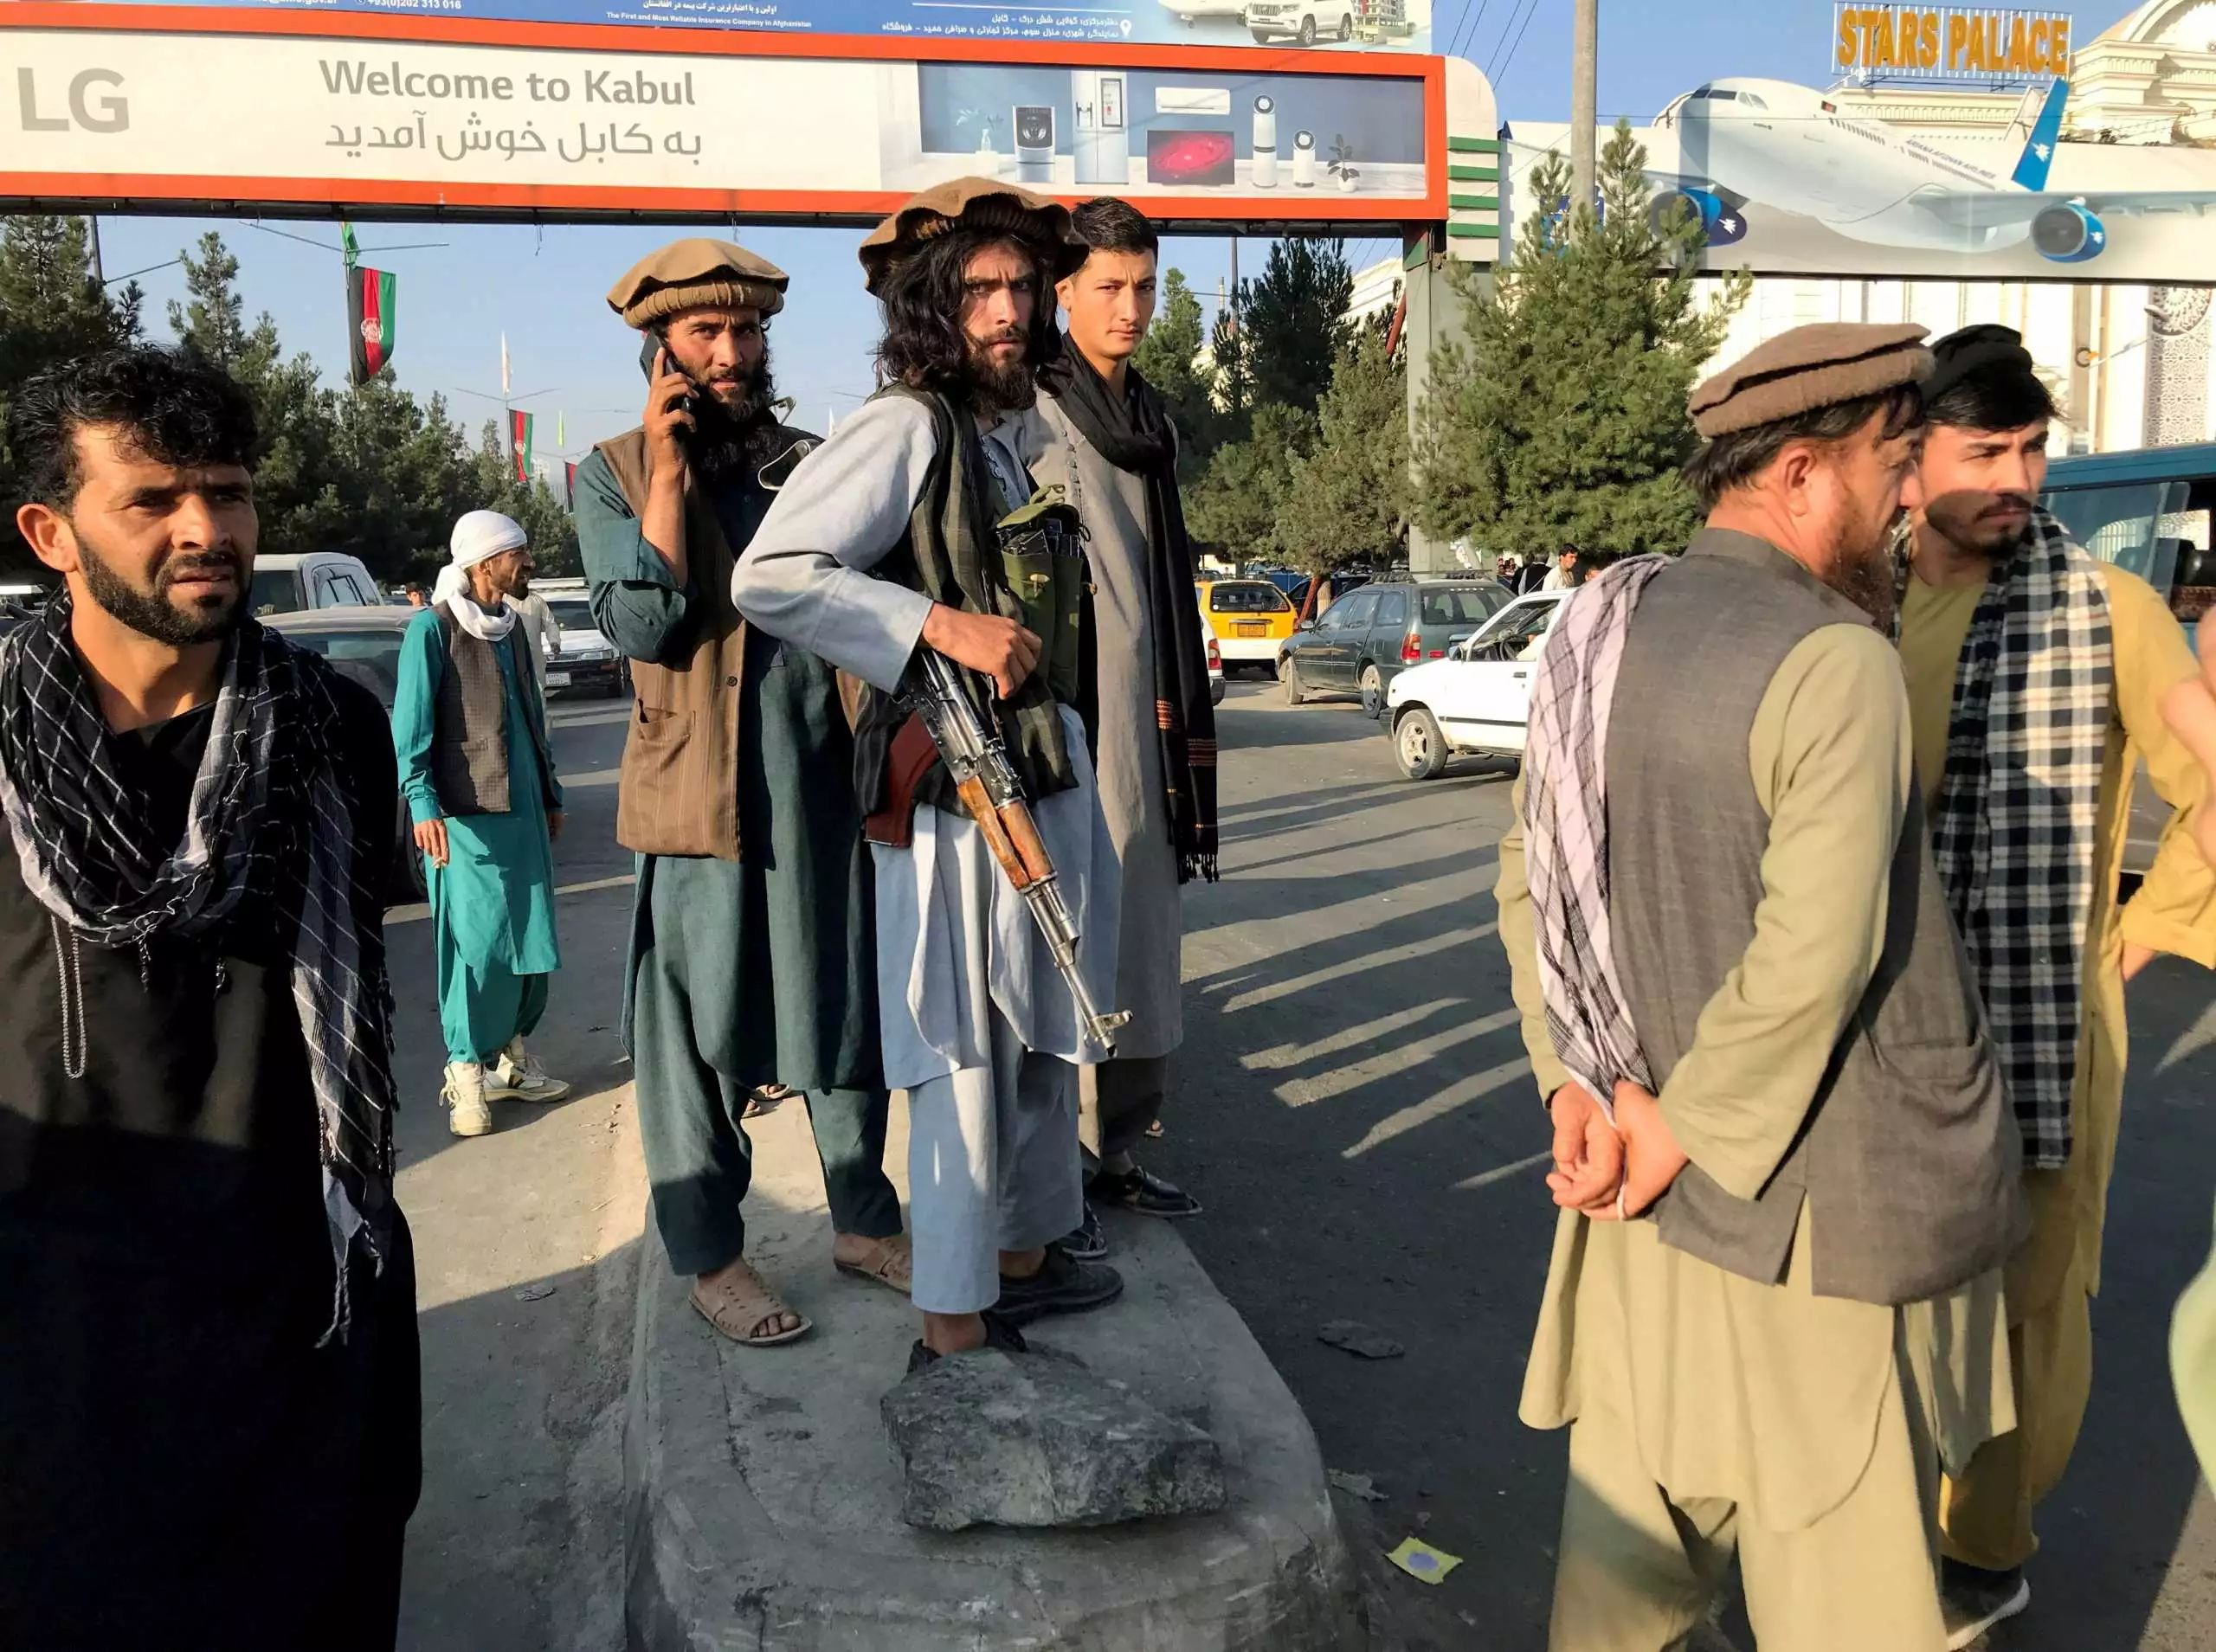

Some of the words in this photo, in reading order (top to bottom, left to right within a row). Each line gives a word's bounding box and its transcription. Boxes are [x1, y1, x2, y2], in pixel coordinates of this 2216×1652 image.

[442, 0, 462, 10] 016
[670, 15, 696, 23] Reliable
[698, 16, 731, 25] Insurance
[732, 17, 763, 27] Company
[1837, 10, 1940, 69] STARS
[1949, 14, 2070, 74] PALACE
[17, 67, 129, 133] LG
[319, 60, 514, 100] Welcome
[526, 73, 571, 102] to
[584, 69, 696, 106] Kabul
[325, 109, 427, 157] آمدید
[436, 111, 547, 162] خوش
[557, 122, 654, 163] کابل
[663, 130, 702, 165] به
